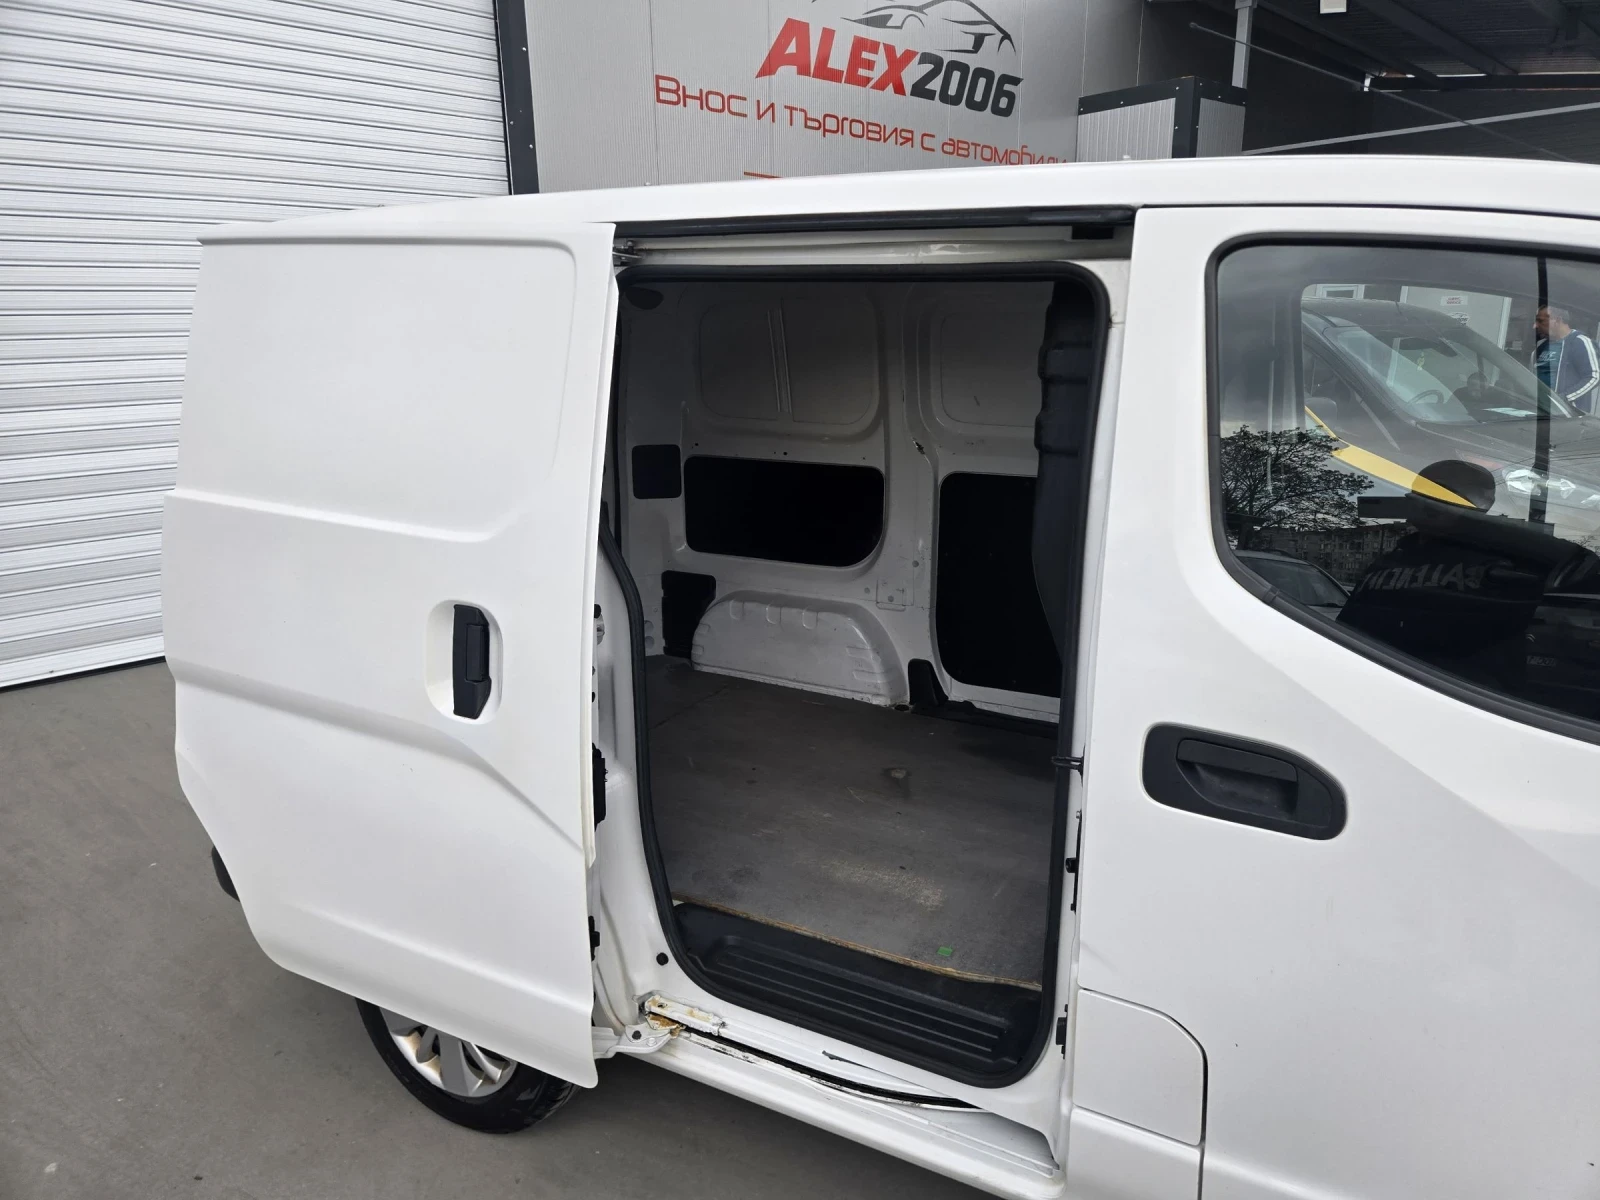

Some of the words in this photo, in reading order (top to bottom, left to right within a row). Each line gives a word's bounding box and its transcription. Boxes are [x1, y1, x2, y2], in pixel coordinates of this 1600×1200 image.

[755, 17, 1024, 118] ALEX2006
[655, 75, 747, 118] Внос
[756, 100, 776, 123] и
[784, 105, 915, 149] търговия
[920, 133, 935, 152] с
